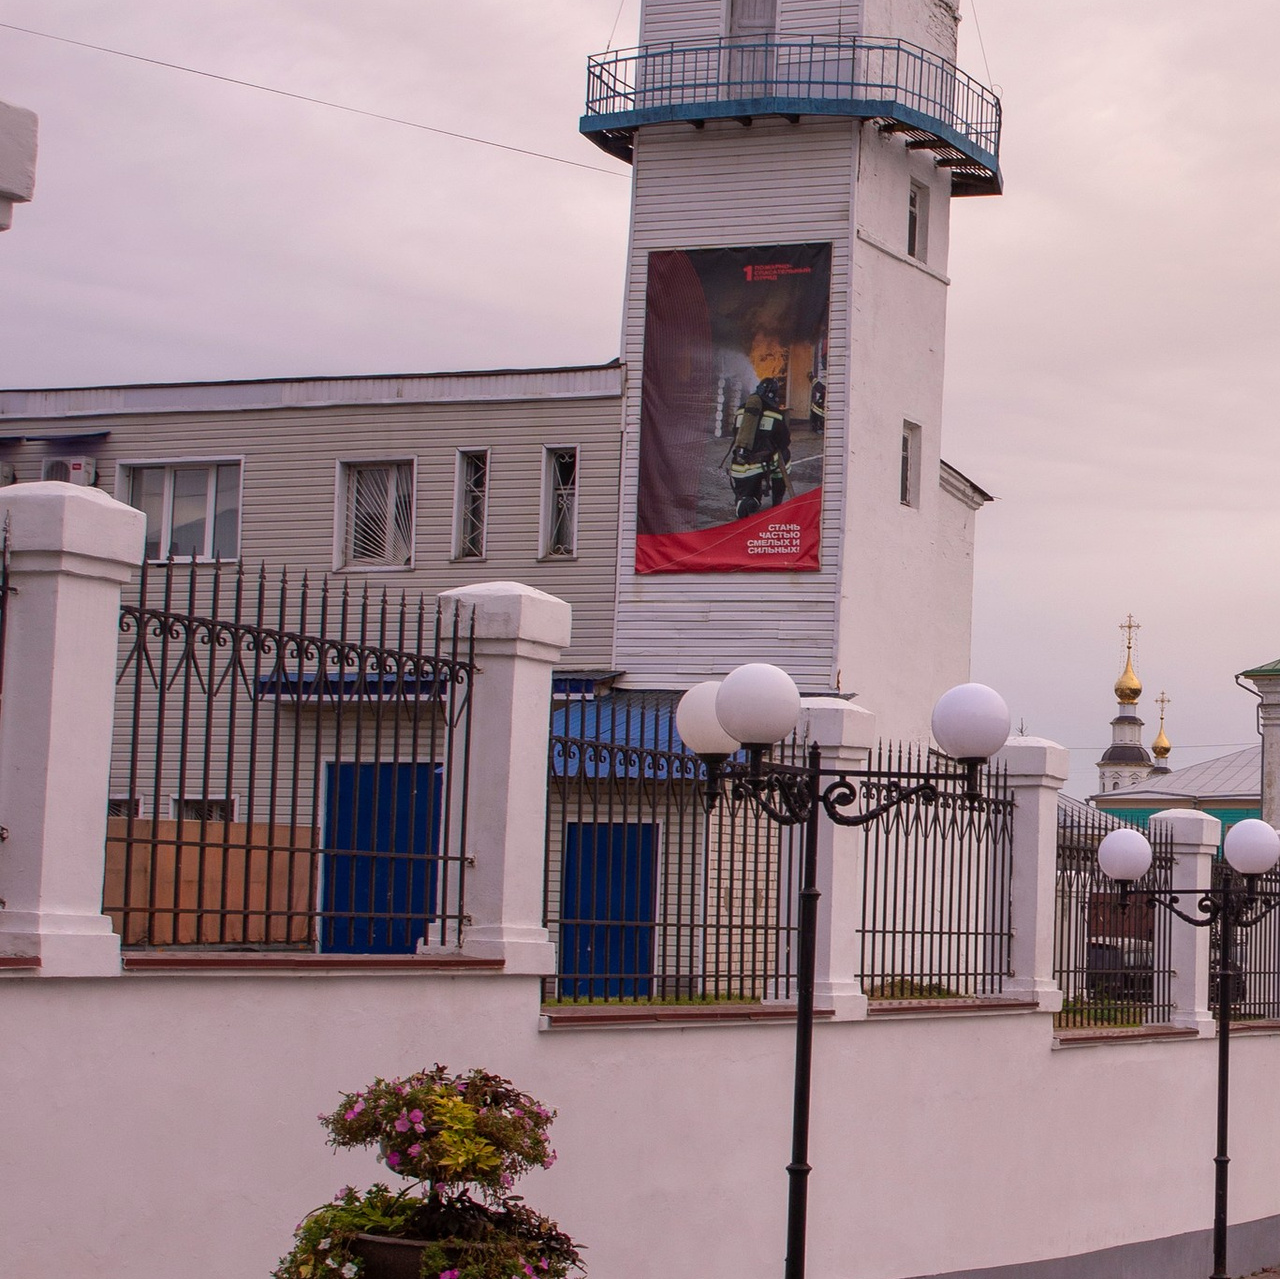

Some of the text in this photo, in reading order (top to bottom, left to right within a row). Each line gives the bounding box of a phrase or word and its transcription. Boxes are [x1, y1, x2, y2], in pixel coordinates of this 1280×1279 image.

[759, 531, 800, 539] ЧАСТЬЮ
[747, 539, 790, 547] СМЕЛЫХ
[748, 546, 800, 554] СИЛЬНЫХ!
